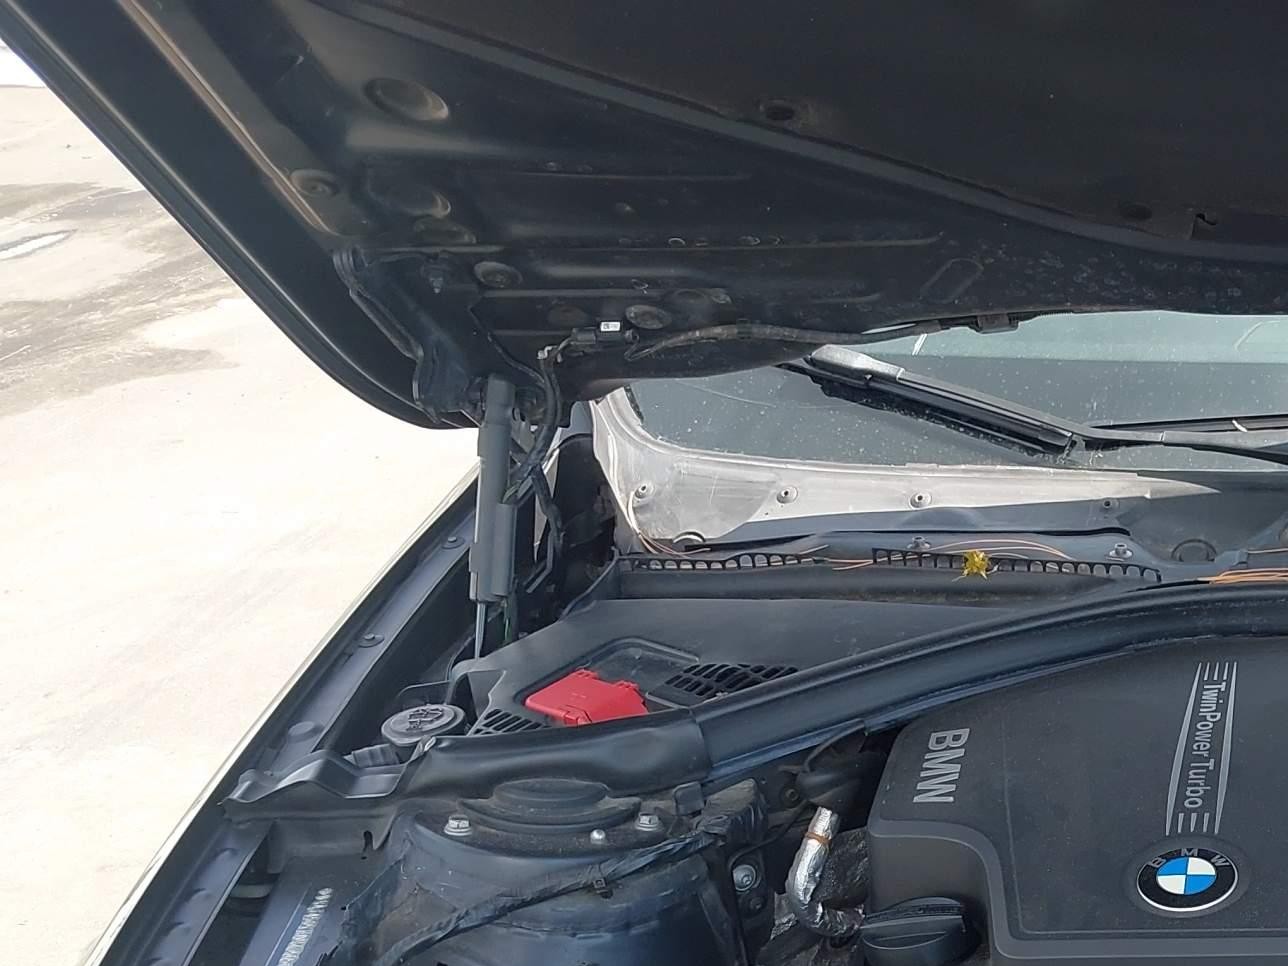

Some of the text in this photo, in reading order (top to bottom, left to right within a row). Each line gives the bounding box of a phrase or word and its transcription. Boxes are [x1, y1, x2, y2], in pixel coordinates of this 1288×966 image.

[913, 728, 970, 803] BMW
[1183, 681, 1227, 809] TwinPower Turbo
[1147, 847, 1231, 869] BMW
